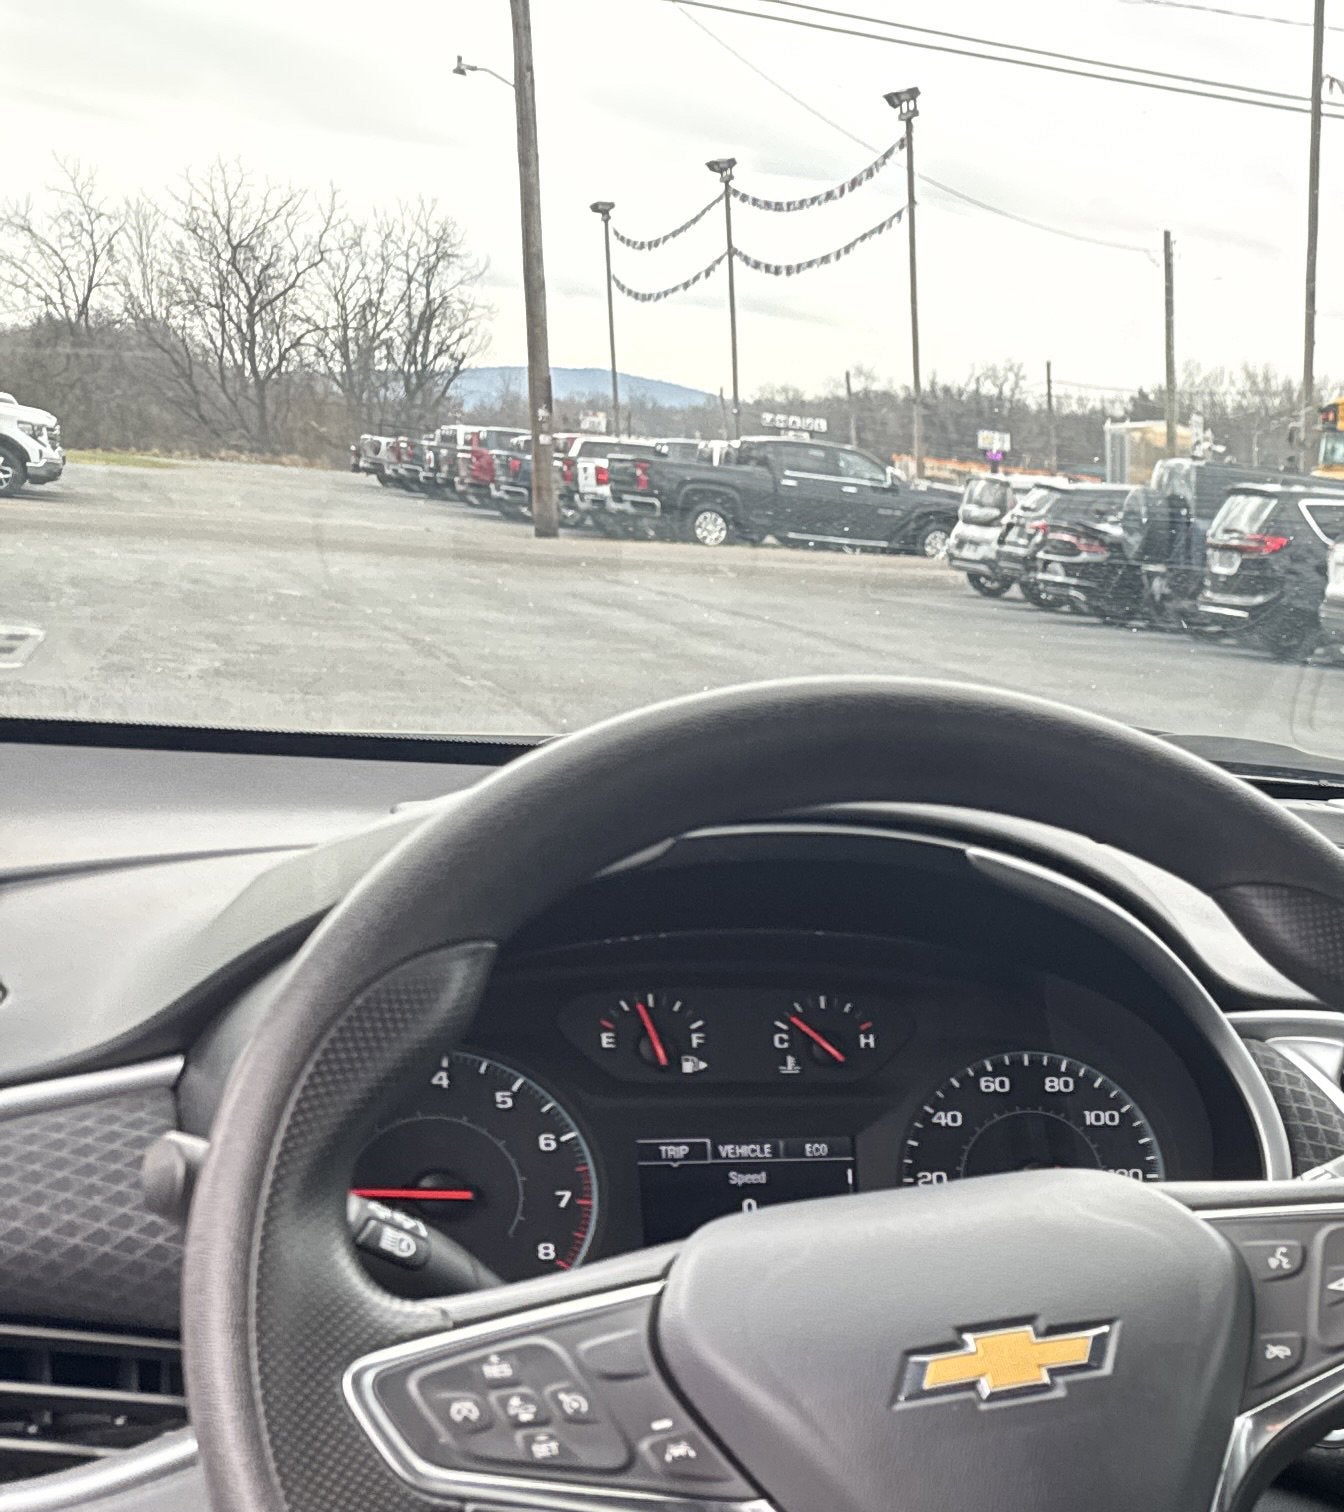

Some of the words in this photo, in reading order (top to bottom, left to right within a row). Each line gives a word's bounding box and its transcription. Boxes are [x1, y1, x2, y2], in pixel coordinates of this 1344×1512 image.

[600, 1032, 616, 1048] E
[691, 1033, 705, 1048] F
[774, 1034, 789, 1049] C
[859, 1033, 875, 1048] H
[431, 1071, 450, 1089] 4
[979, 1076, 1011, 1093] 60
[1044, 1076, 1074, 1093] 80
[495, 1092, 513, 1109] 5
[931, 1110, 963, 1127] 40
[1083, 1110, 1120, 1126] 100
[538, 1133, 557, 1151] 6
[804, 1143, 828, 1156] ECO
[659, 1145, 690, 1159] TRIP
[718, 1144, 772, 1158] VEHICLE
[728, 1171, 767, 1187] Speed
[916, 1171, 947, 1186] 20
[554, 1190, 572, 1208] 7
[538, 1243, 555, 1260] 8
